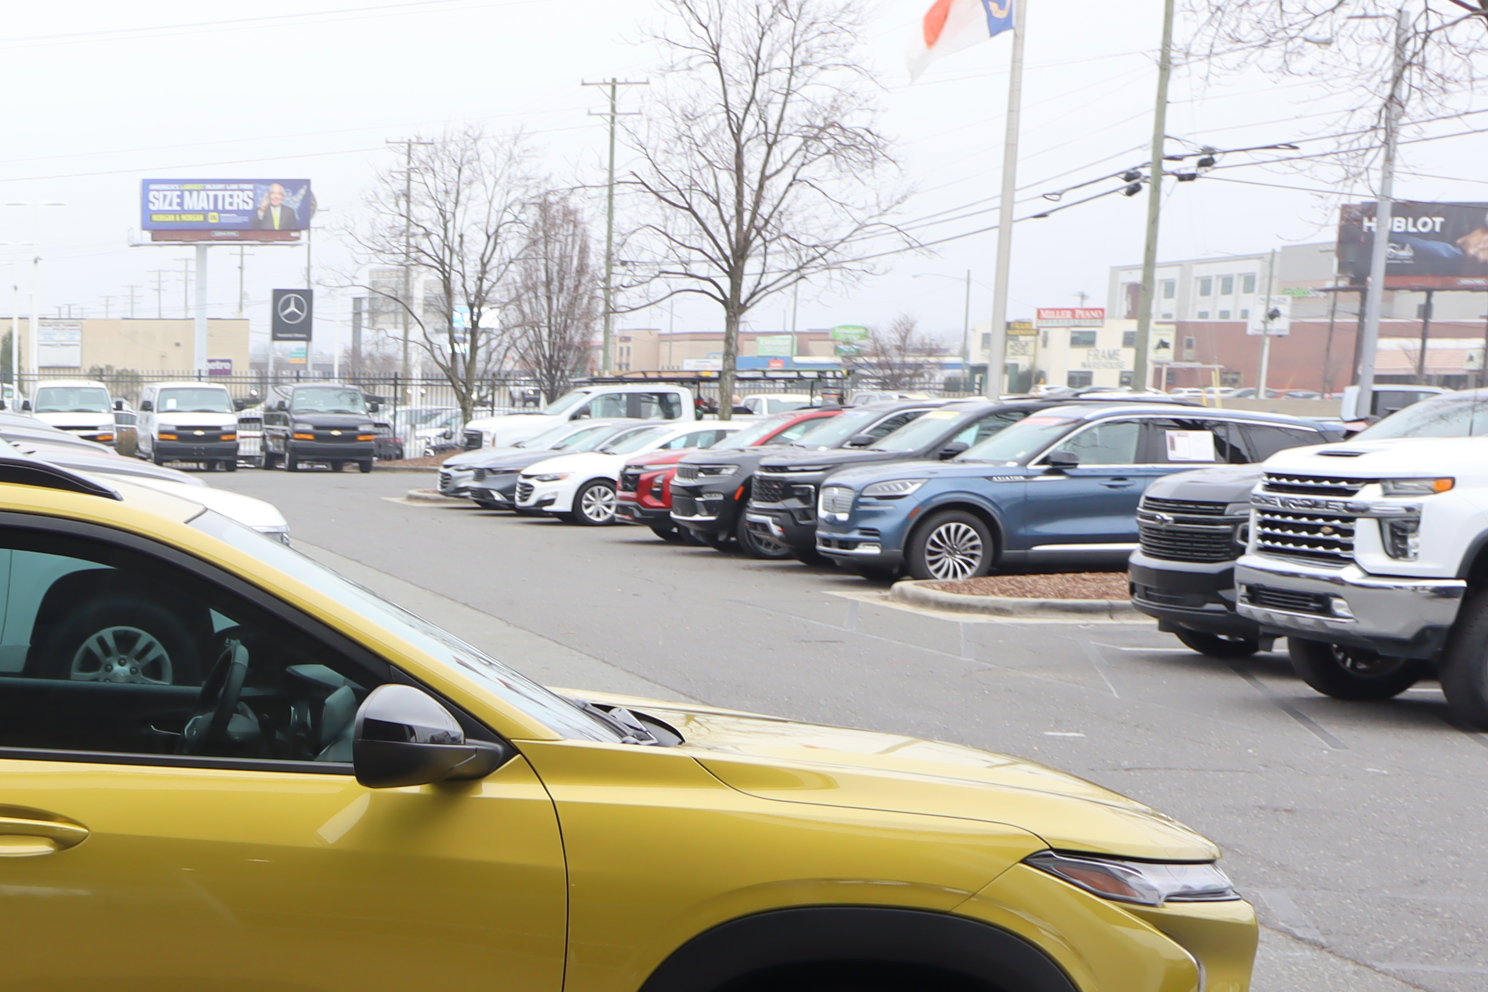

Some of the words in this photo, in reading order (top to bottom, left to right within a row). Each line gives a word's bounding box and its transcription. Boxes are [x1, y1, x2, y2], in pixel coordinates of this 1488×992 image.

[149, 190, 181, 210] SIZE
[184, 190, 254, 210] MATTERS
[1362, 216, 1445, 233] HBLOT
[207, 360, 231, 371] etro
